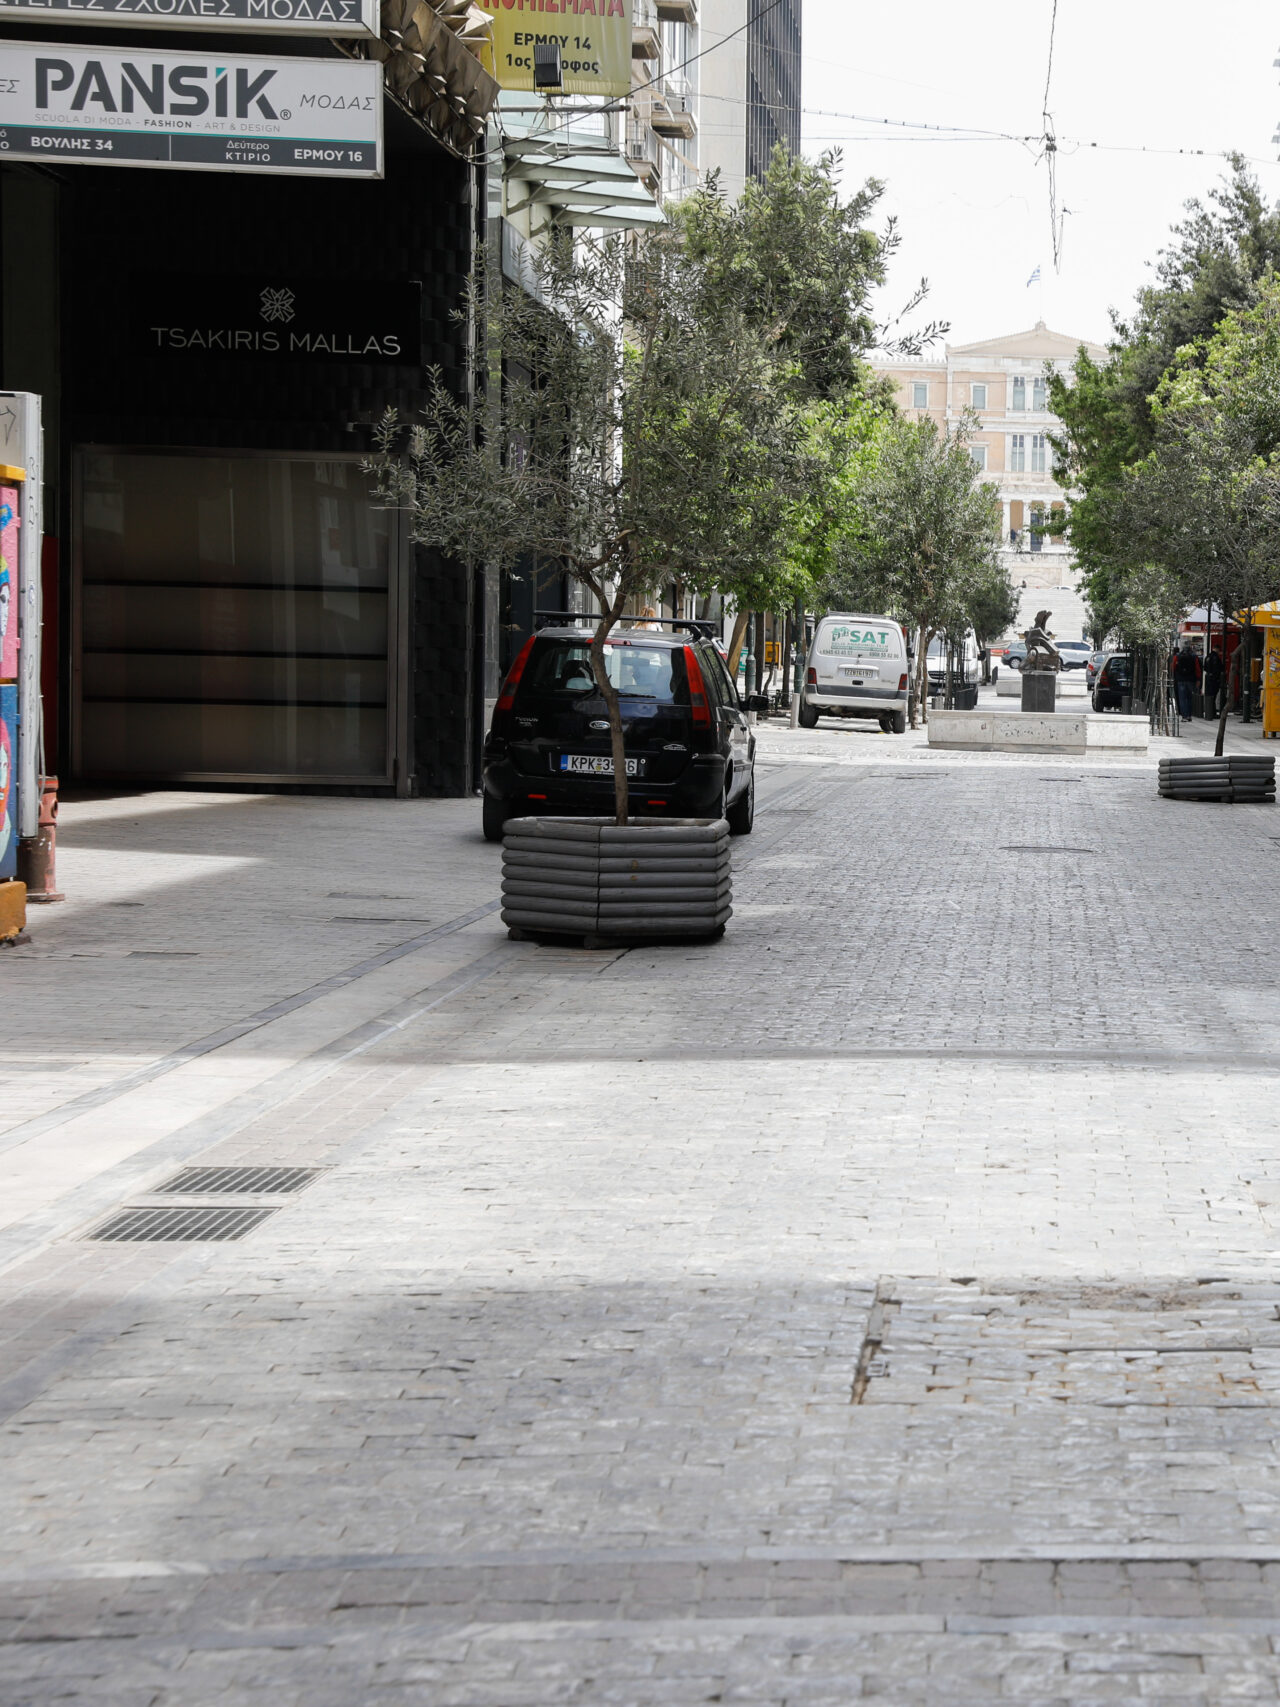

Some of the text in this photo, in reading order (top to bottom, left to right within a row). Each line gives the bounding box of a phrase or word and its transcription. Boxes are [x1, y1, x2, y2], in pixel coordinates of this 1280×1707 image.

[247, 0, 356, 21] ΜΟΔΑΣ
[514, 32, 592, 50] ΕΡΜΟΥ 14
[299, 94, 376, 111] ΜΟΔΑΣ
[34, 113, 79, 123] SCUOLA
[99, 117, 131, 126] MODA
[144, 119, 192, 128] FASHION
[240, 124, 281, 133] DESIGN
[31, 136, 114, 151] ΒΟΥΛΗΣ 34
[226, 140, 270, 151] Δεύτερο
[225, 152, 271, 162] ΚΤΙΡΙΟ
[294, 149, 363, 162] ΕΡΜΟΥ 16
[150, 327, 401, 356] TSAKIRIS MALLAS
